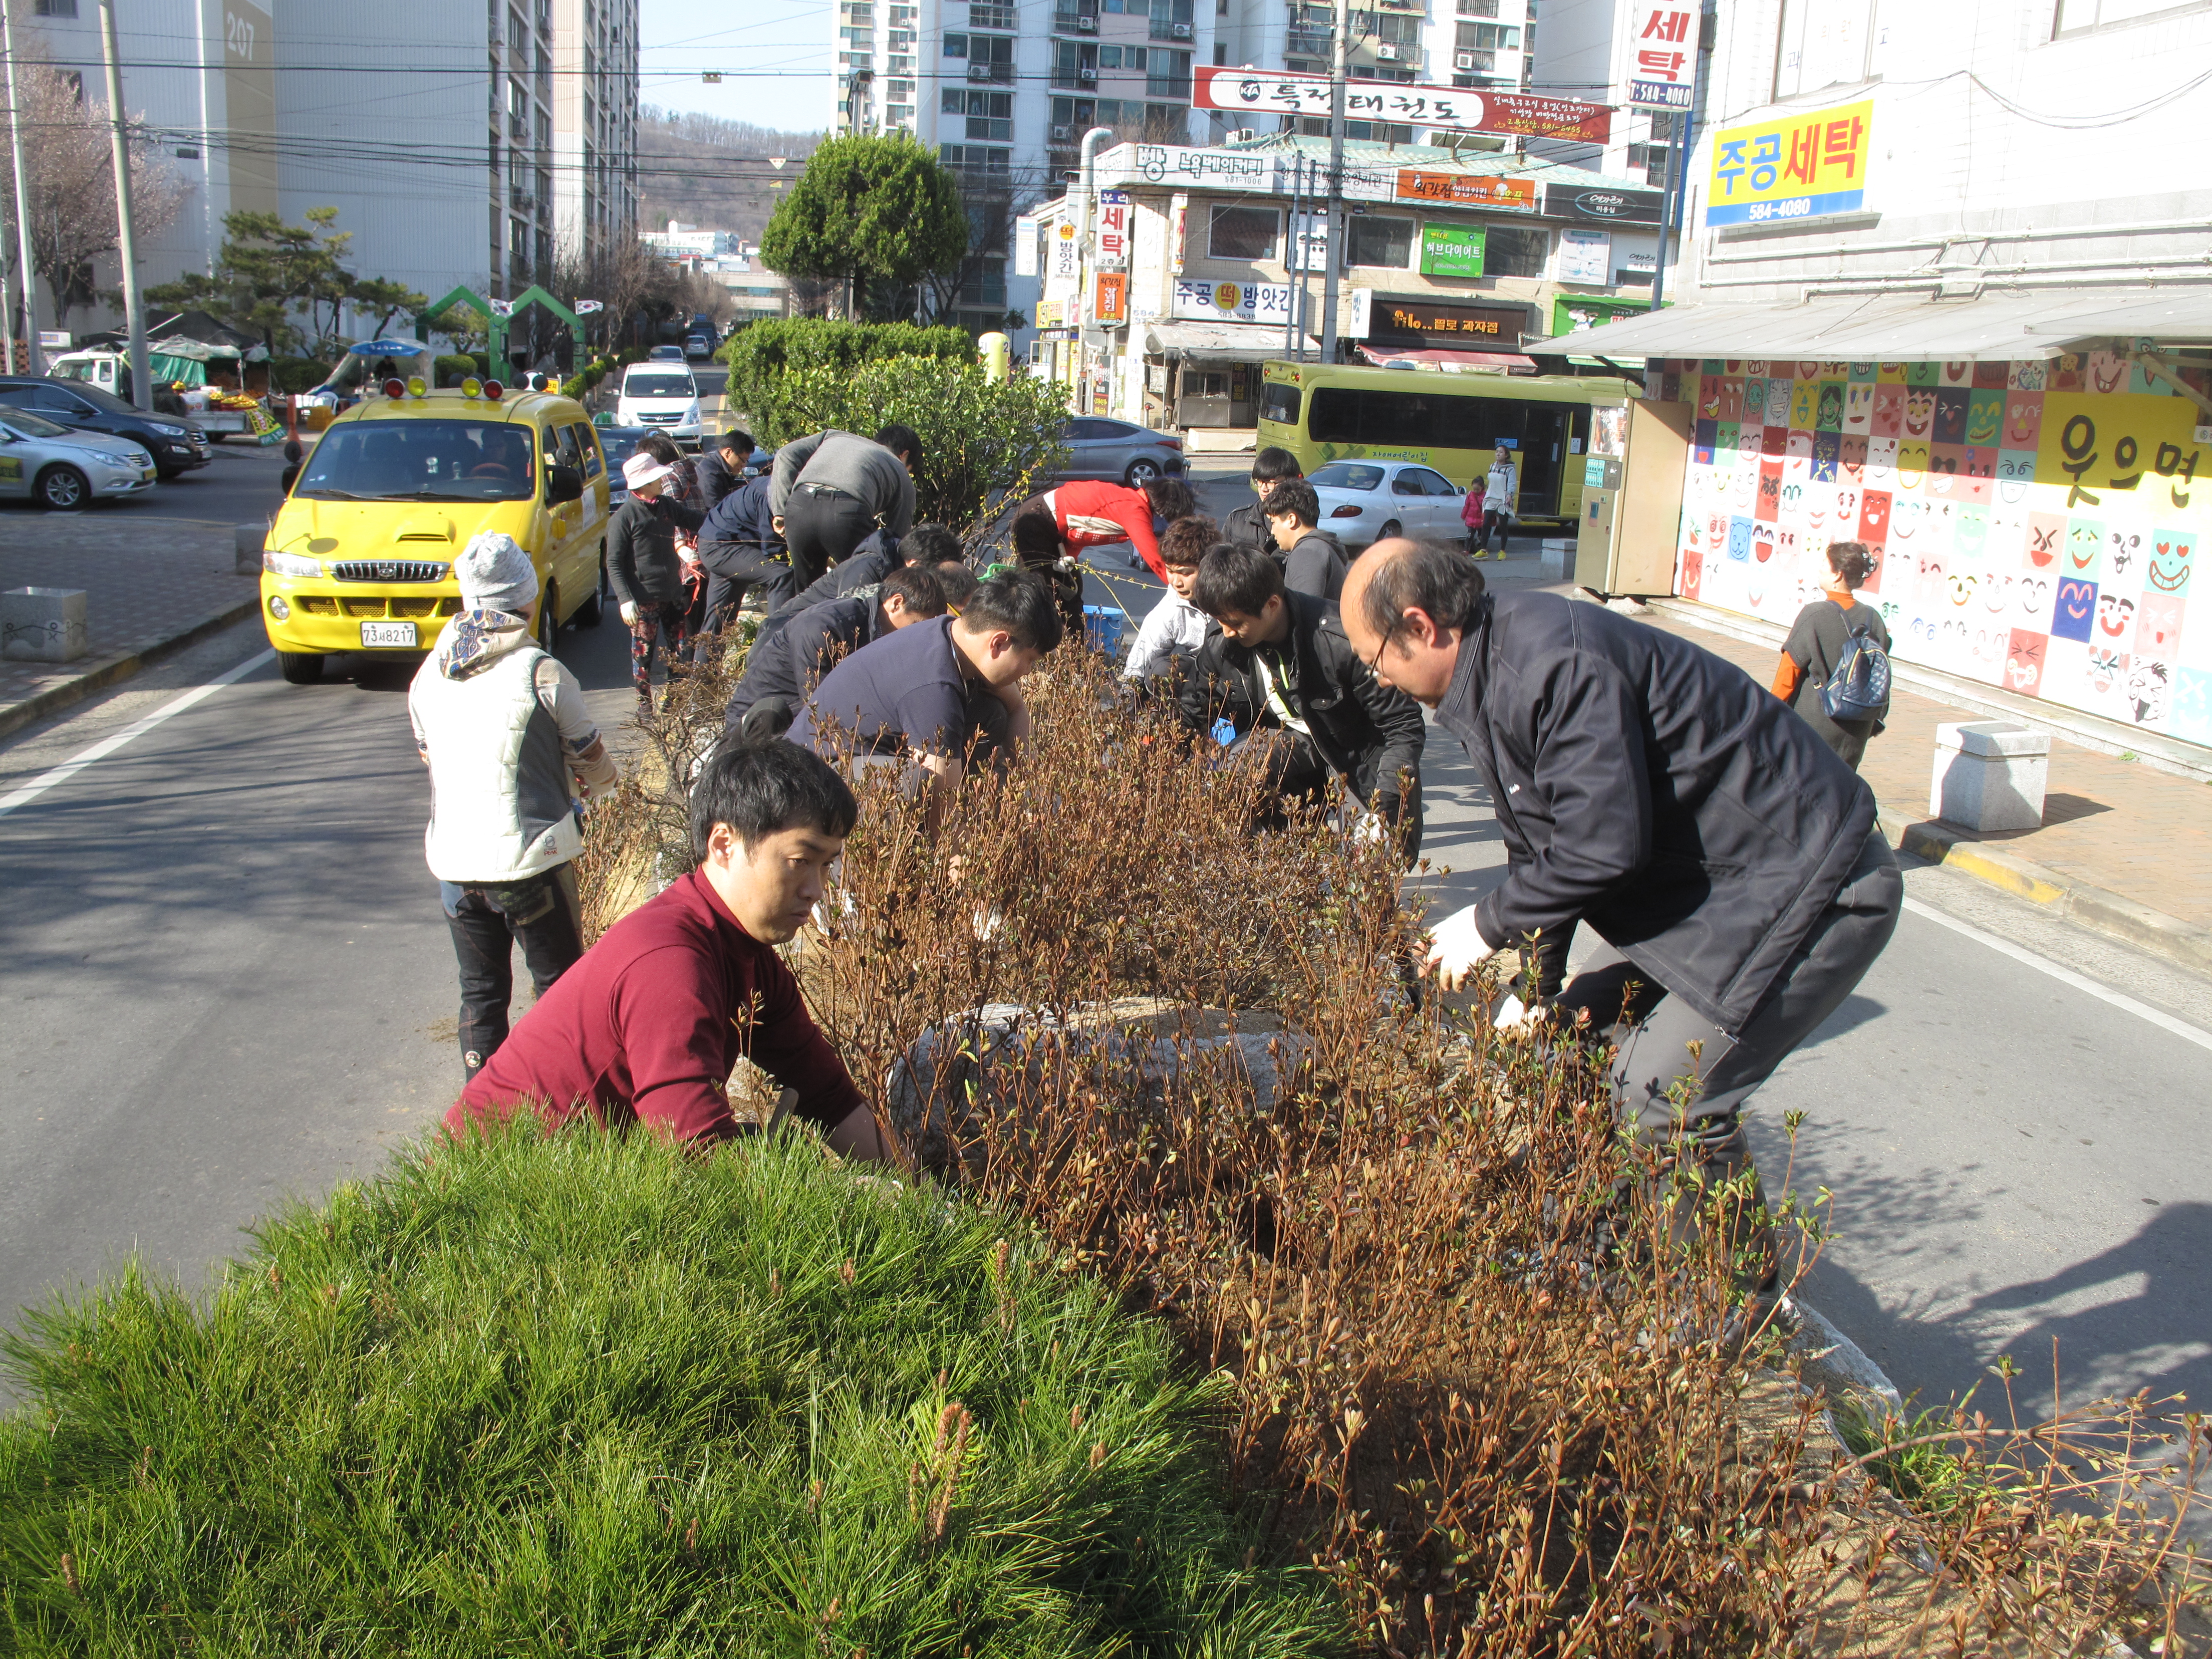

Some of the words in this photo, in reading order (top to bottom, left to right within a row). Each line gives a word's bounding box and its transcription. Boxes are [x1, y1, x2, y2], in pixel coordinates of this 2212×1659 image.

[227, 12, 254, 61] 207
[1136, 146, 1167, 182] 빵
[1179, 152, 1263, 179] 뉴욕베이커리
[1225, 176, 1262, 185] 581-1006
[1102, 193, 1129, 204] 우리
[1416, 182, 1451, 198] 외갓집
[1452, 185, 1488, 199] 양념치킨
[1749, 198, 1811, 220] 584-4080
[1060, 227, 1073, 238] 떡
[1102, 207, 1125, 257] 세탁
[1059, 241, 1074, 273] 방앗간
[1426, 242, 1481, 259] 허브다이어트
[1177, 283, 1212, 306] 주공
[1220, 285, 1236, 308] 떡
[1434, 318, 1458, 331] 필로
[1462, 320, 1499, 334] 과자점
[1372, 450, 1429, 463] 자애어린이집
[363, 630, 414, 642] 73서8217
